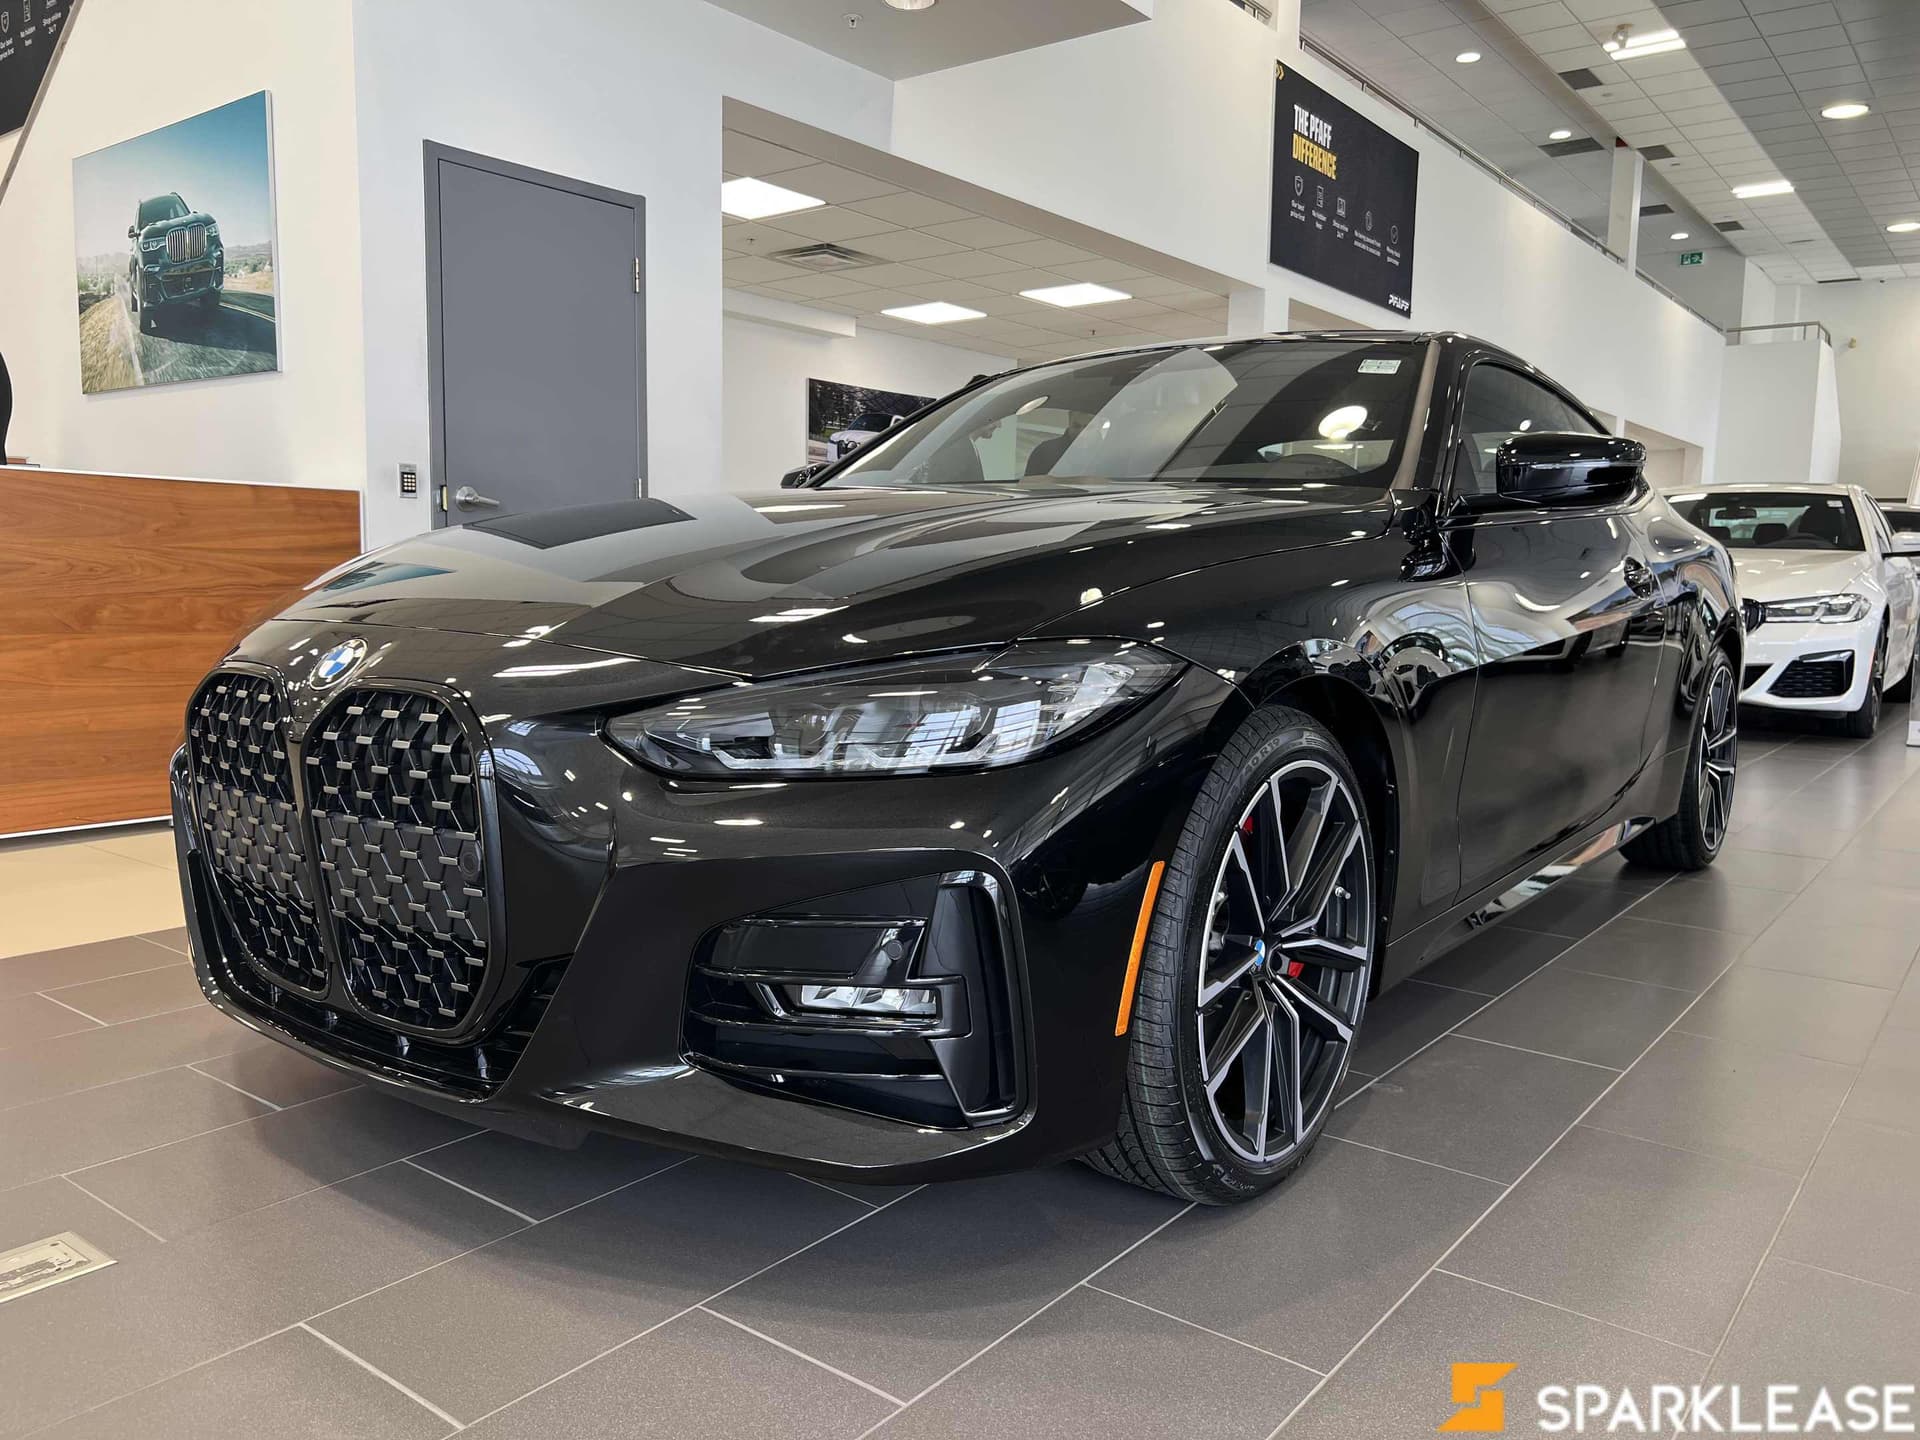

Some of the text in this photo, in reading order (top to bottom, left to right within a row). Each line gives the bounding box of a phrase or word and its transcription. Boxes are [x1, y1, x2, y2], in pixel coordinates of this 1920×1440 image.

[1294, 104, 1332, 149] THE PFAFF
[1292, 132, 1337, 180] DIFFERENCE
